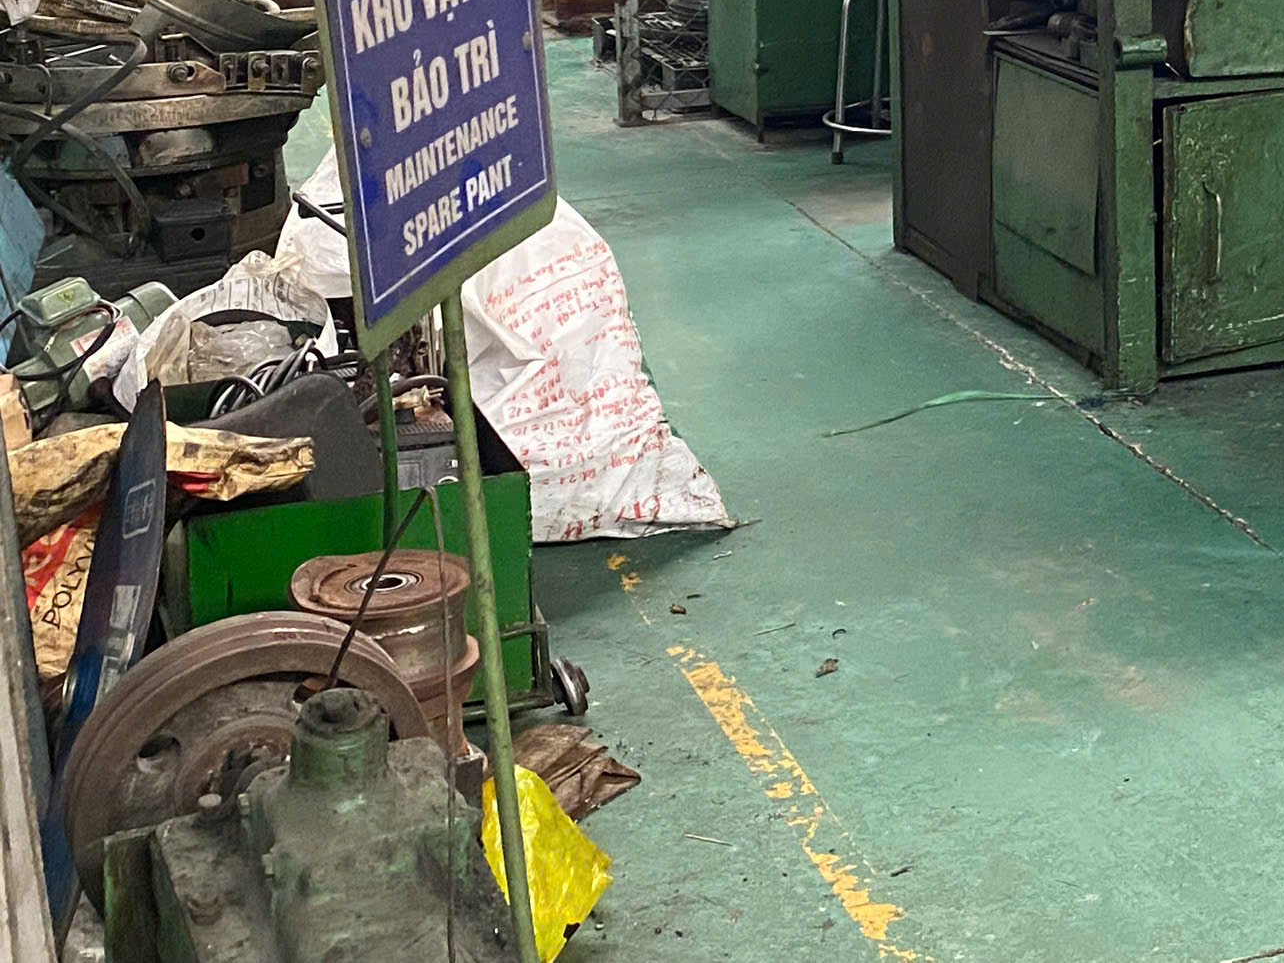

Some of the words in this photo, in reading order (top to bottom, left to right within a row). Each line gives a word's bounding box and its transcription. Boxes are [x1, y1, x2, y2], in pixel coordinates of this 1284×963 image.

[390, 48, 449, 133] BẢO
[454, 19, 500, 95] TRÌ
[385, 94, 519, 205] MAINTENANCE
[403, 186, 463, 256] SPARE
[465, 154, 512, 212] PANT
